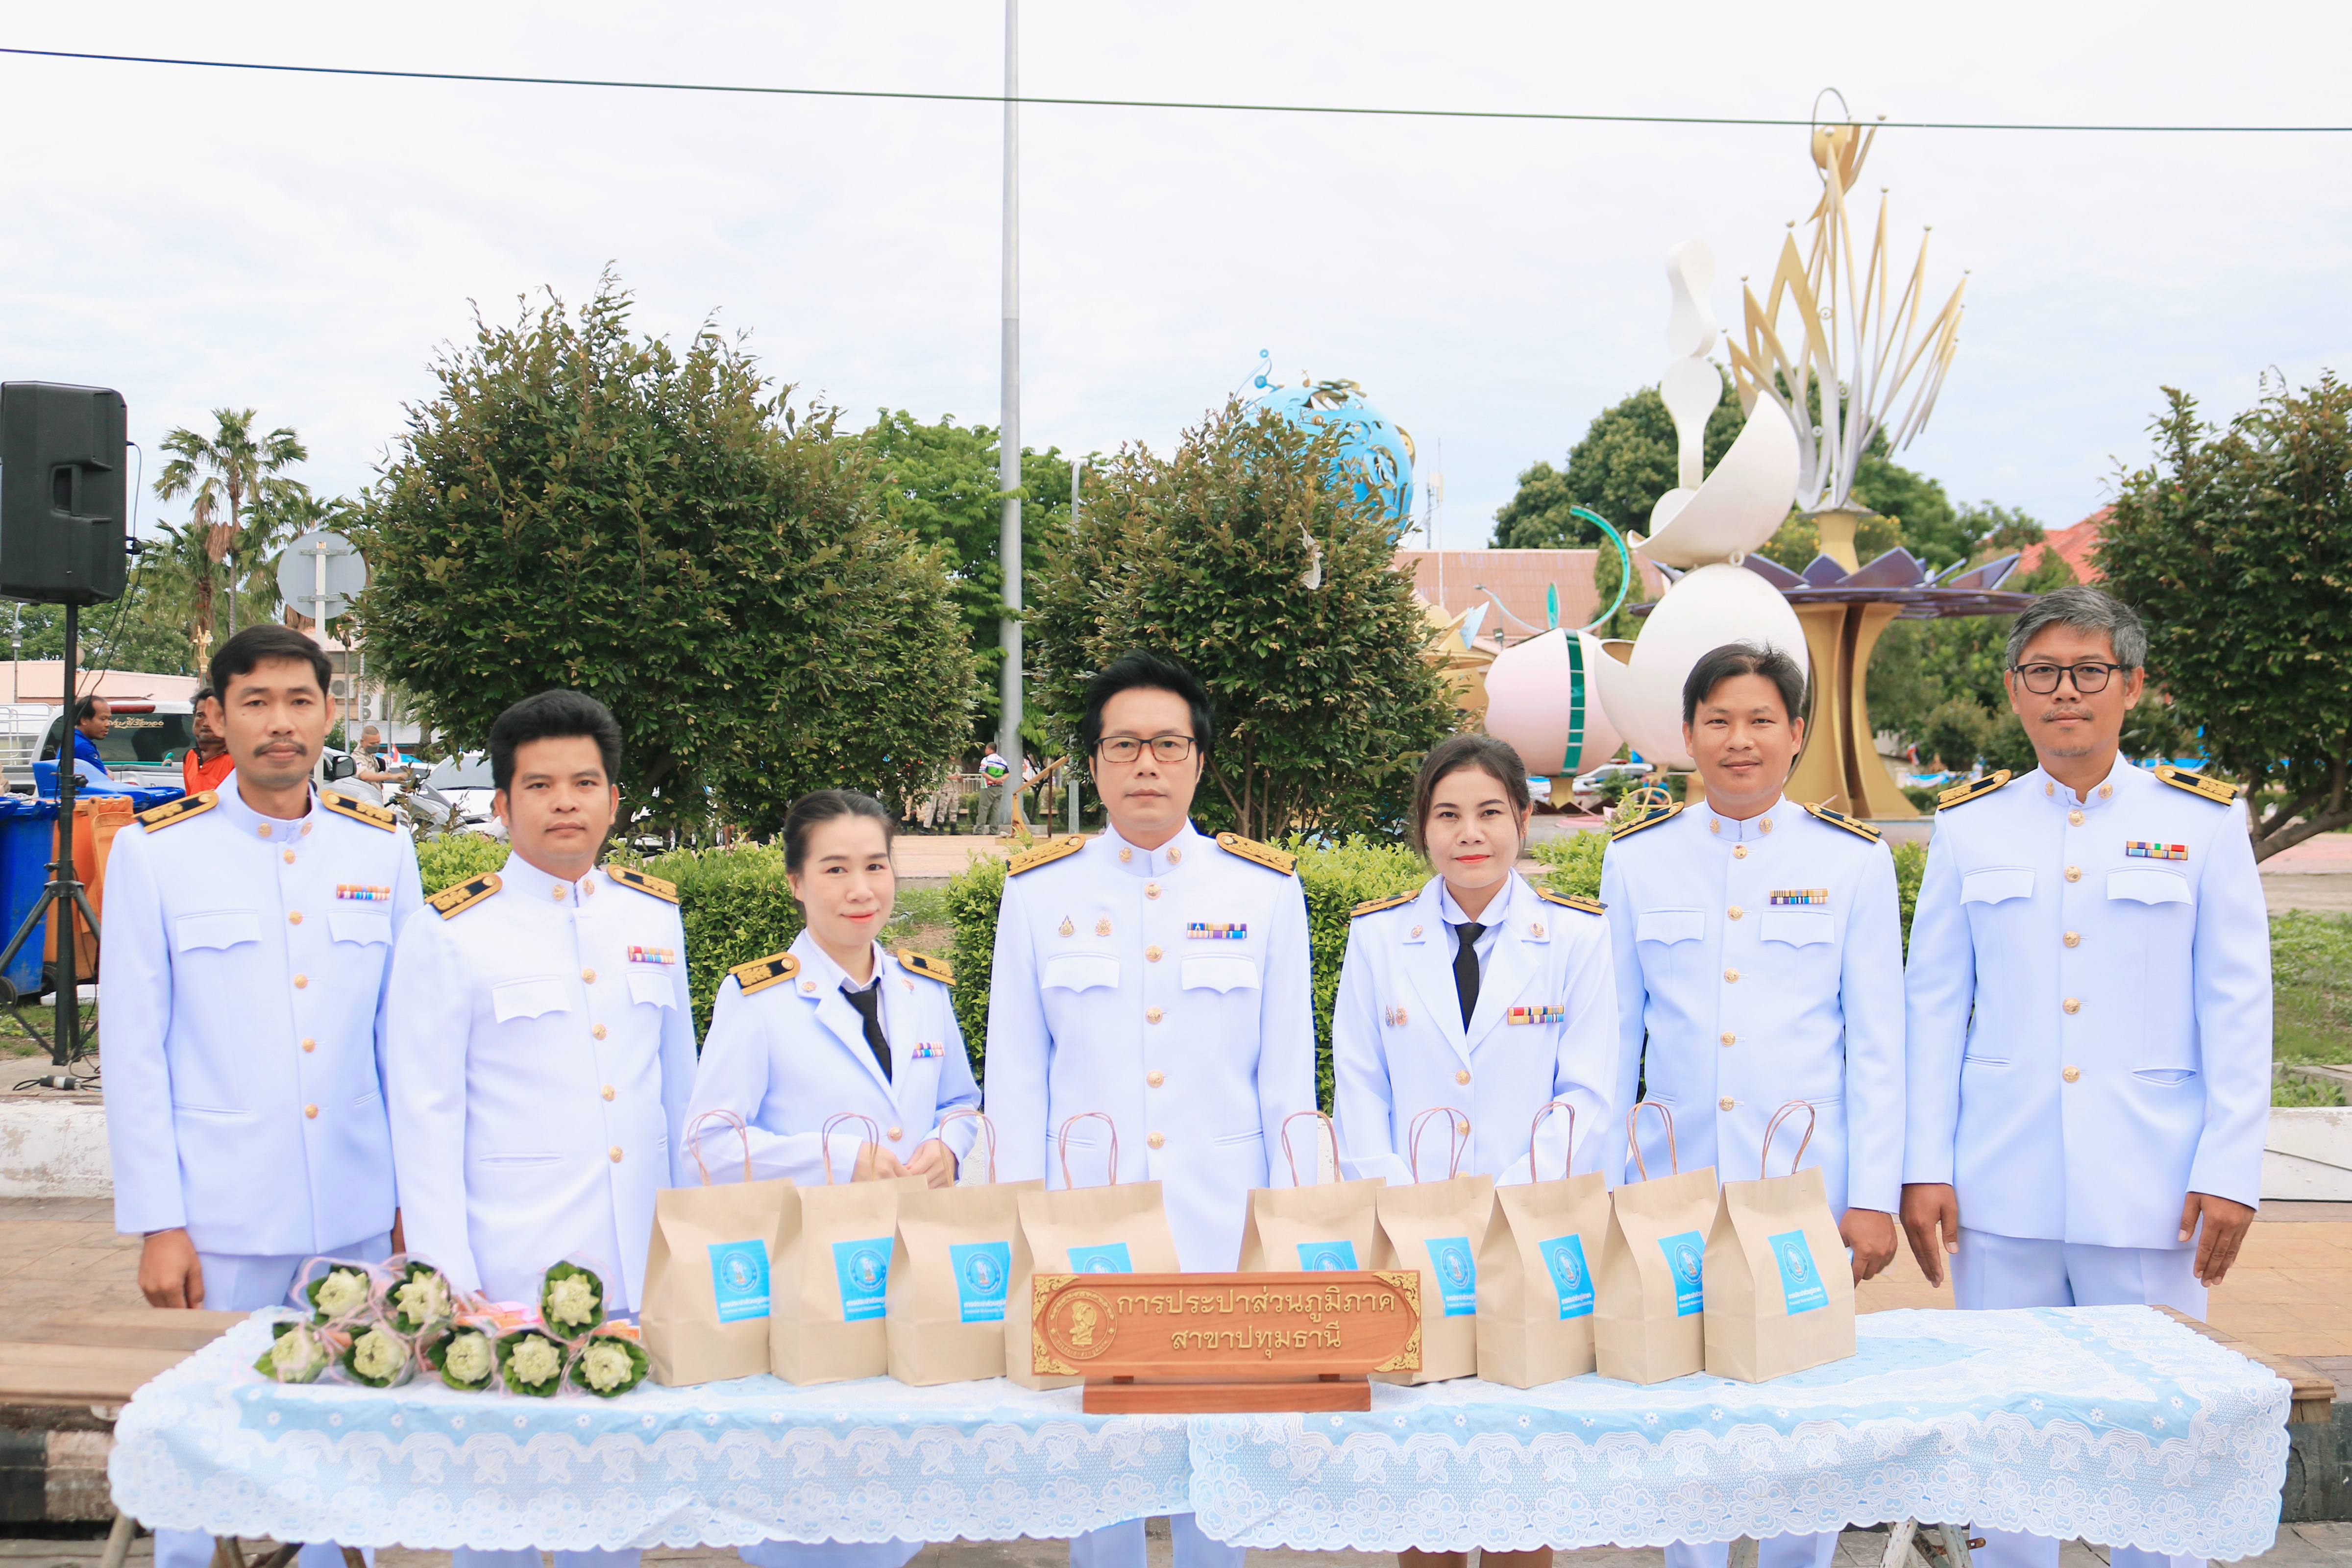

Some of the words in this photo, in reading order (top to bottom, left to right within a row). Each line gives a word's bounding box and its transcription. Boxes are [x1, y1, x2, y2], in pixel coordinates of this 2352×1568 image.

[1117, 1286, 1395, 1323] การประปาส่วนภูมิภาค
[1171, 1321, 1341, 1359] สาขาปทุมธานี
